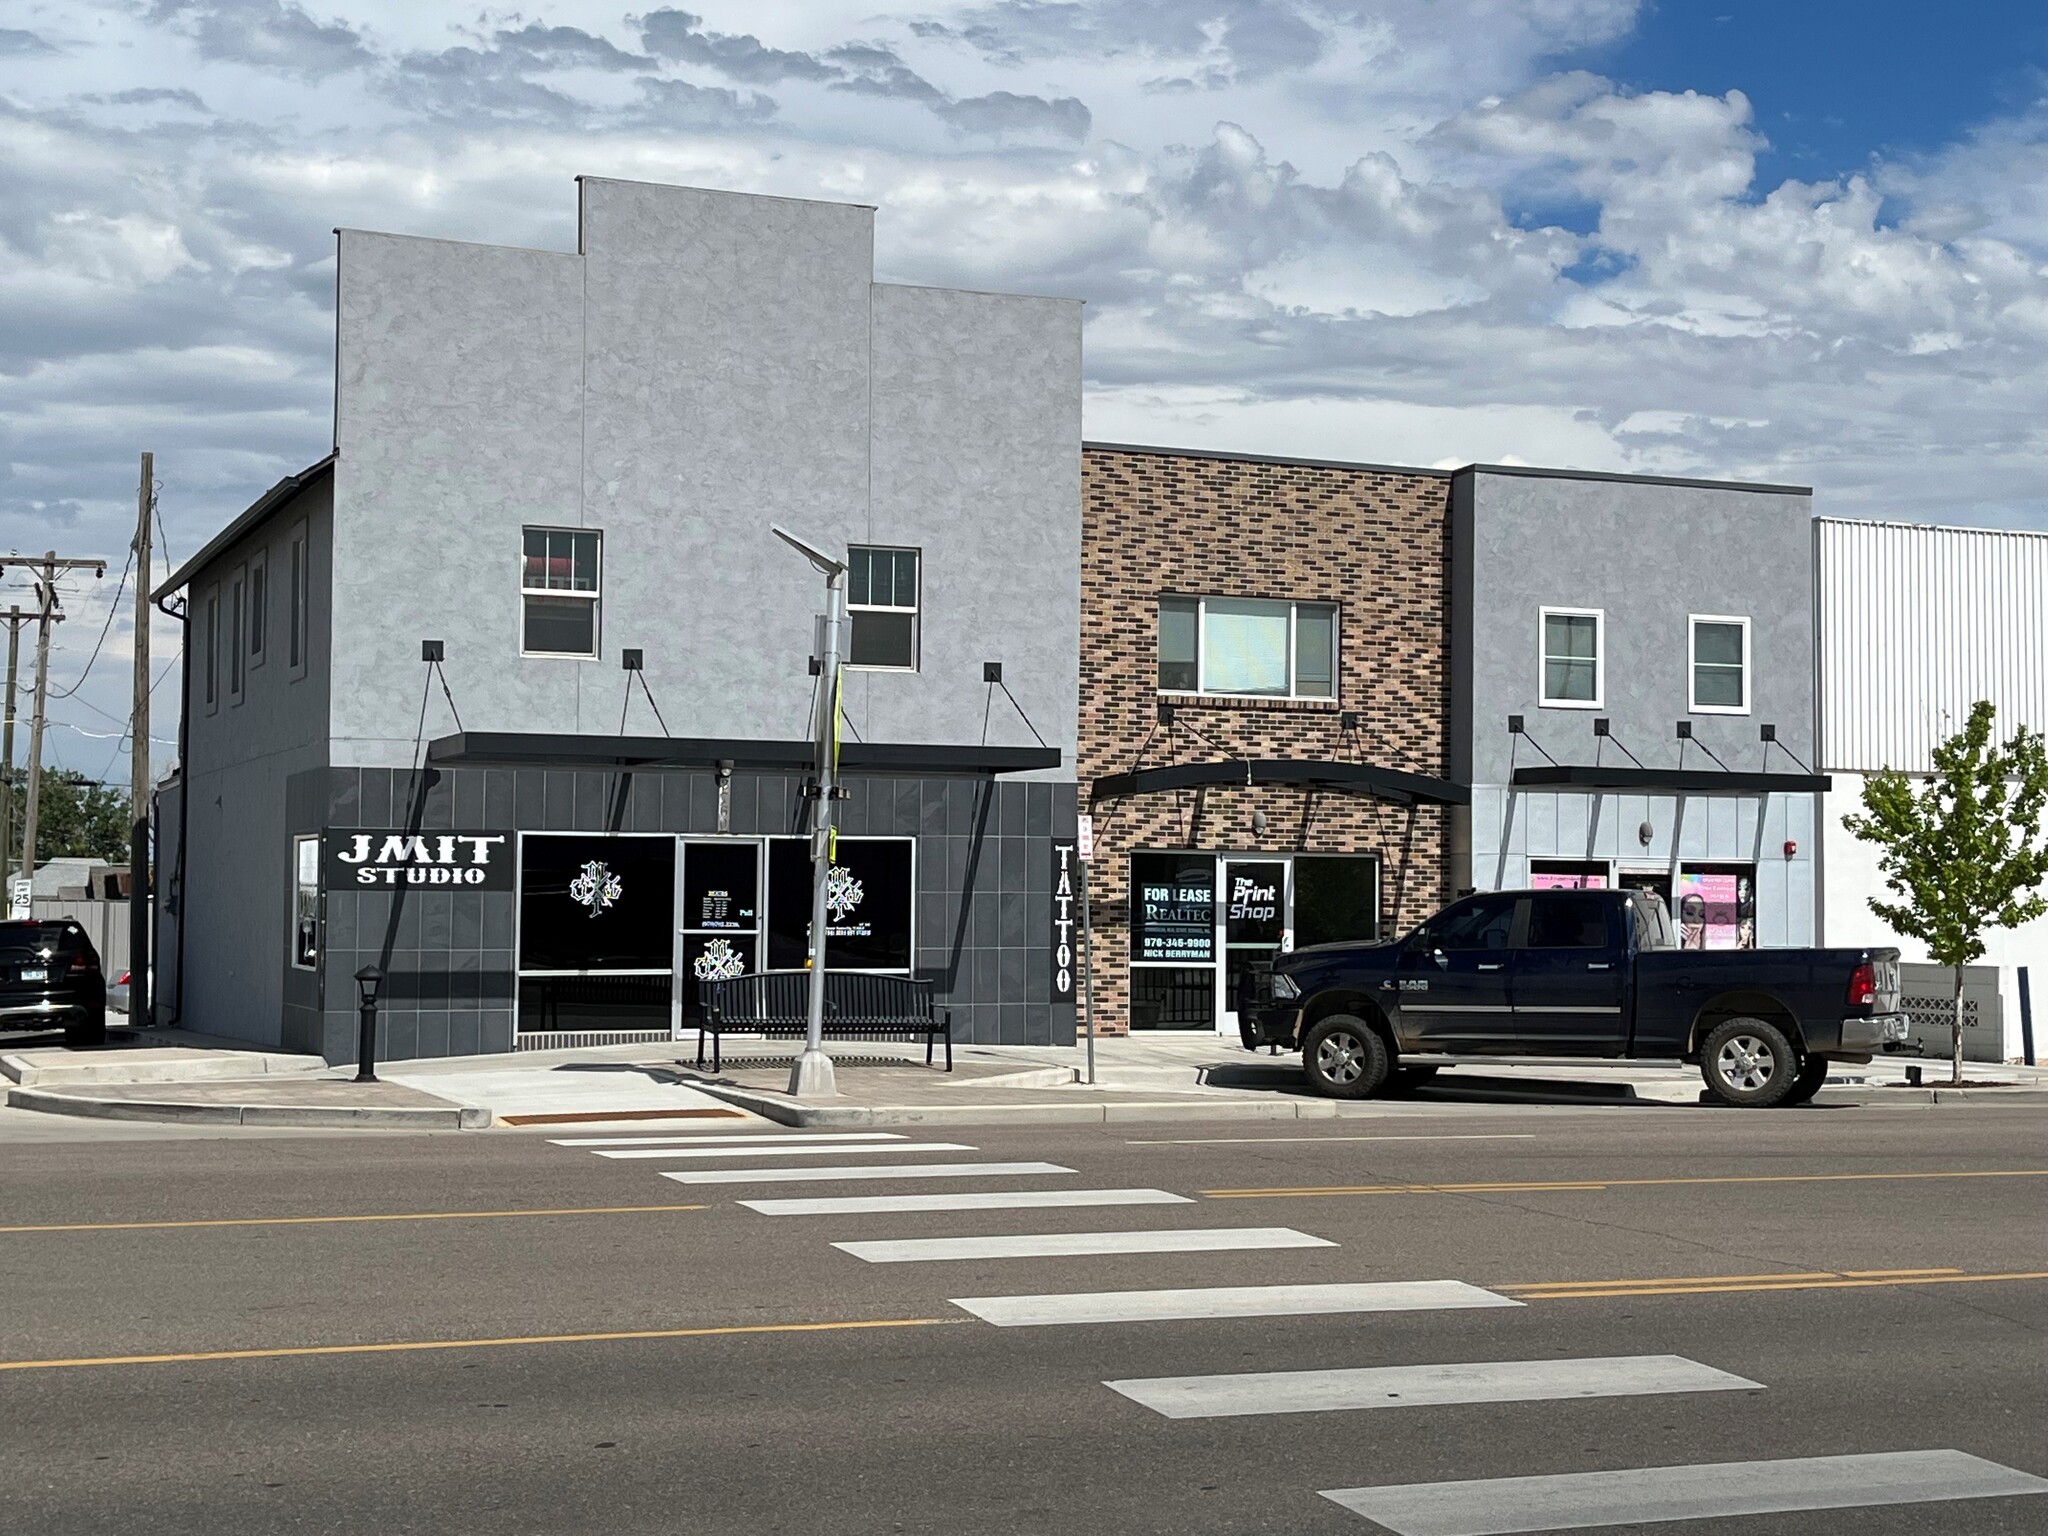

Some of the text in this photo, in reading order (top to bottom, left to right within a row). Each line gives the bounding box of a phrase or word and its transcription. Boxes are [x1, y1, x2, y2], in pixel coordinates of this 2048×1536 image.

[337, 834, 506, 864] JMIT
[356, 866, 486, 885] STUDIO
[1234, 877, 1254, 887] The
[15, 894, 29, 904] 25
[1143, 887, 1211, 903] FOR LEASE
[1232, 885, 1276, 905] Print
[1055, 844, 1074, 993] TATTOO
[1229, 903, 1276, 922] Shop
[1144, 937, 1211, 948] 970-346-9900
[1143, 949, 1211, 959] NICK BERRYMAN
